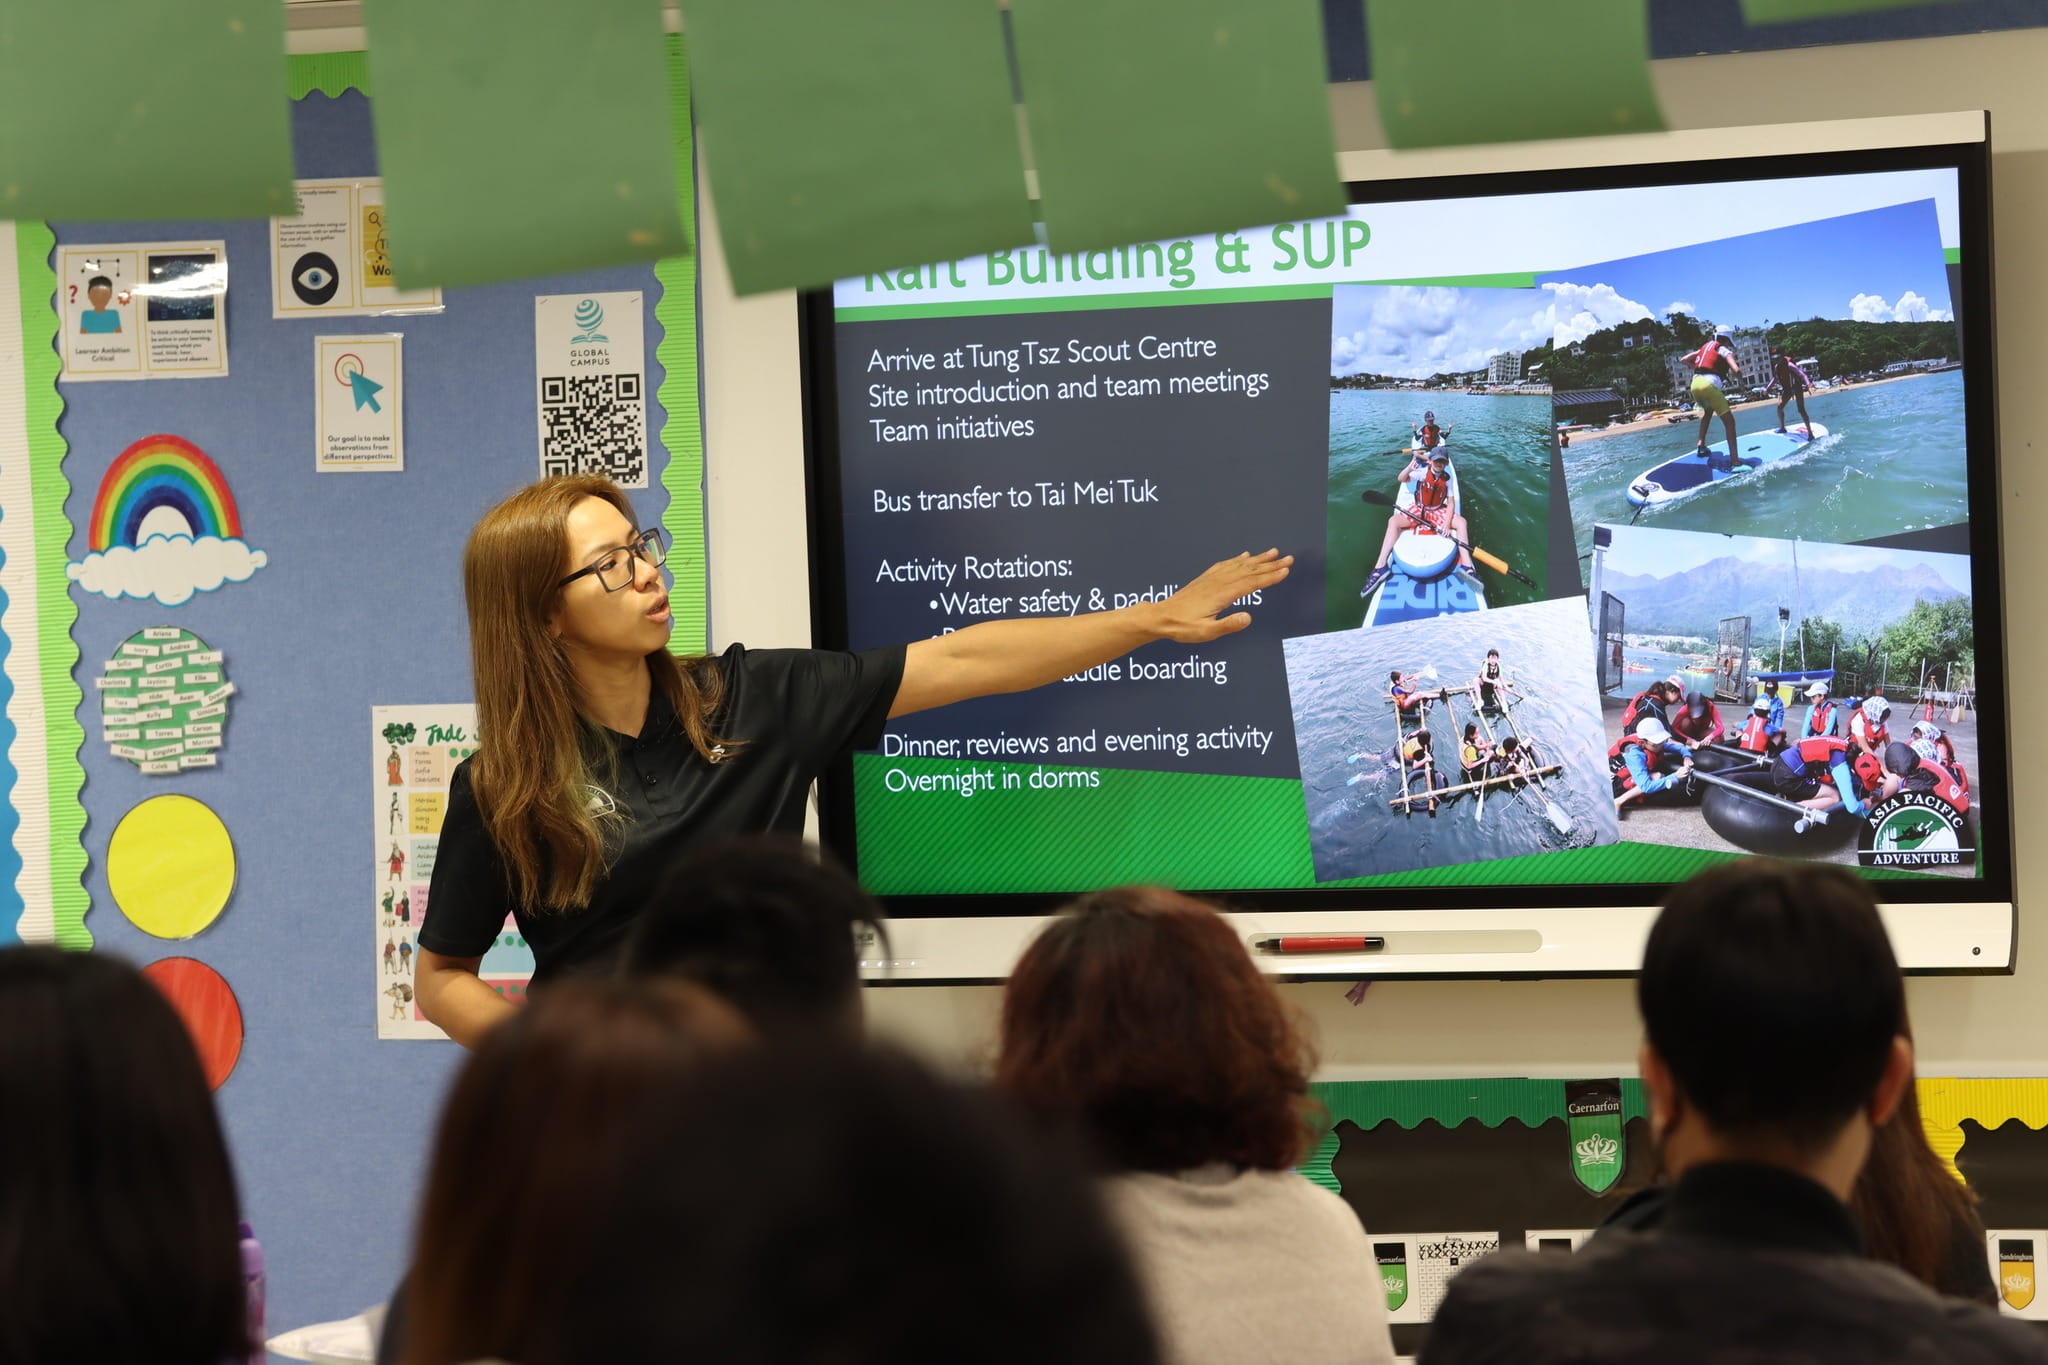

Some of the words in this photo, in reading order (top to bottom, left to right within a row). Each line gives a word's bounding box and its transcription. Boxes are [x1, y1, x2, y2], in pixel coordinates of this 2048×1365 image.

[1215, 231, 1250, 274] &
[1272, 220, 1371, 272] SUP
[372, 264, 392, 276] Wo
[570, 348, 609, 358] GLOBAL
[570, 358, 610, 367] CAMPUS
[867, 347, 936, 373] Arrive
[943, 348, 964, 369] at
[966, 344, 1020, 373] Tung
[1021, 341, 1061, 365] Tsz
[1067, 339, 1132, 363] Scout
[1138, 335, 1217, 360] Centre
[869, 383, 909, 408] Site
[916, 378, 1050, 406] introduction
[1057, 374, 1097, 399] and
[1104, 375, 1161, 397] team
[1169, 367, 1270, 397] meetings
[341, 434, 356, 443] goal
[372, 434, 390, 442] make
[869, 418, 929, 443] Team
[937, 413, 1036, 440] initiatives
[373, 443, 389, 451] from
[874, 489, 912, 513] Bus
[917, 485, 1002, 511] transfer
[1007, 486, 1032, 508] to
[1035, 482, 1065, 507] Tai
[1074, 480, 1114, 505] Mei
[1117, 478, 1159, 503] Tuk
[876, 557, 957, 587] Activity
[964, 554, 1073, 580] Rotations:
[940, 591, 1013, 615] Water
[1019, 588, 1082, 616] safety
[1088, 587, 1106, 610] &
[1114, 583, 1179, 611] paddl
[1129, 655, 1227, 685] boarding
[425, 723, 467, 746] Jade
[884, 733, 961, 758] Dinner,
[967, 731, 1049, 756] reviews
[1057, 729, 1096, 752] and
[1104, 726, 1190, 757] evening
[1196, 724, 1273, 755] activity
[885, 765, 996, 798] Overnight
[1002, 766, 1020, 790] in
[1029, 765, 1100, 789] dorms
[1869, 797, 1901, 829] ASIA
[1903, 793, 1964, 829] PACIFIC
[1873, 852, 1960, 865] ADVENTURE
[1568, 1100, 1620, 1114] Caernarfon
